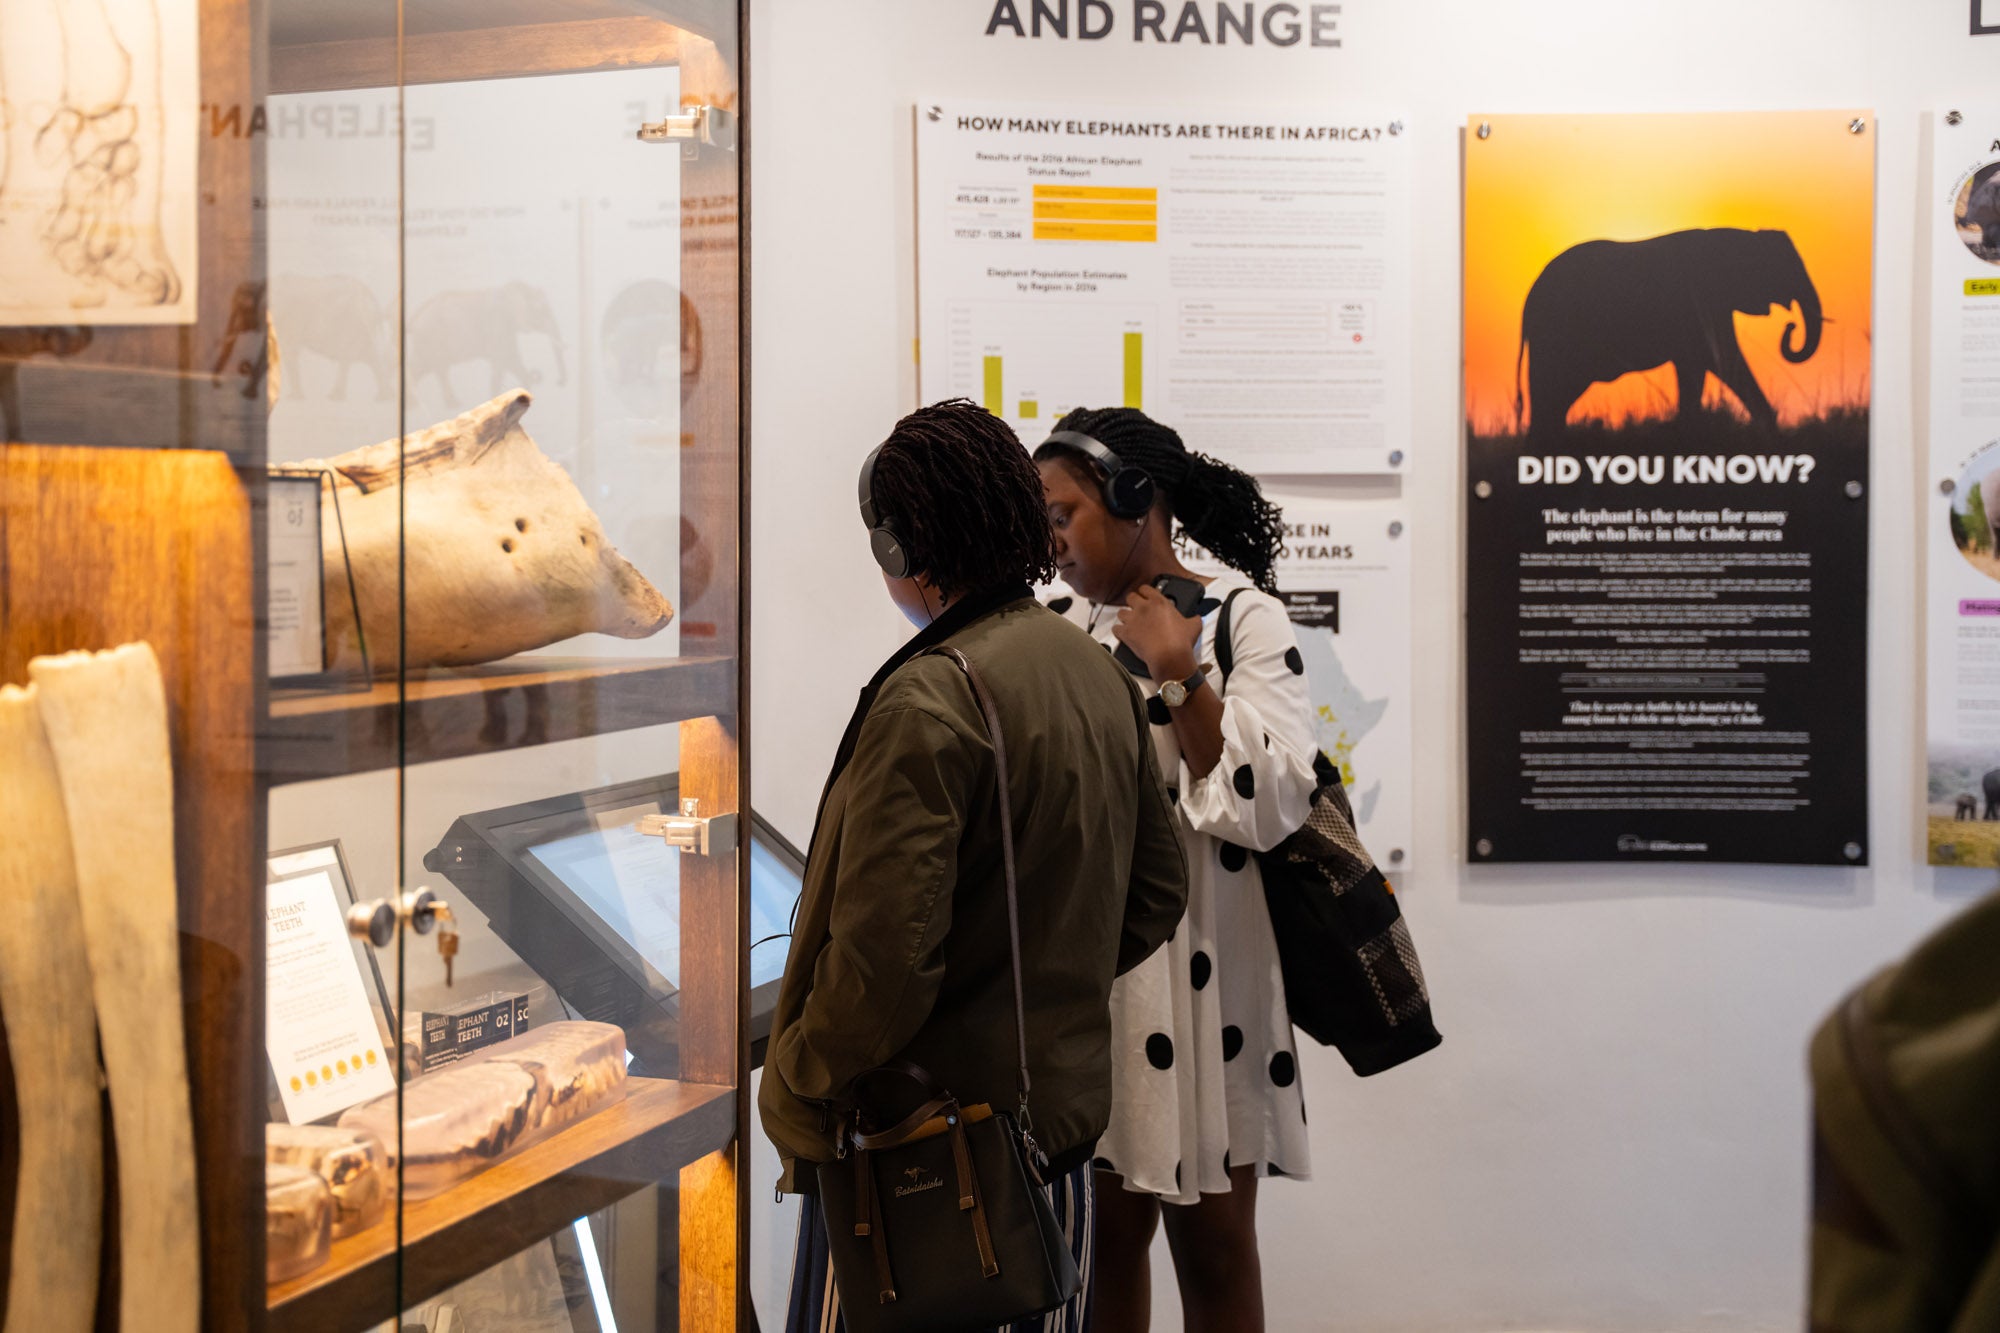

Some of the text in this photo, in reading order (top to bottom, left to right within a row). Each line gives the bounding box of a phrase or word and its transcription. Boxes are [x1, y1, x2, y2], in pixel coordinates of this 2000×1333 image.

[984, 0, 1342, 47] AND RANGE
[957, 116, 1381, 141] HOW MANY ELEPHANTS ARE THERE IN AFRICA?
[975, 151, 1010, 162] Results
[1013, 153, 1022, 162] of
[1023, 153, 1039, 163] the
[1066, 155, 1098, 165] African
[1101, 156, 1142, 167] Elephant
[1027, 167, 1091, 179] Status Report
[987, 267, 1128, 280] Elephant Population Estimates
[1017, 282, 1028, 292] by
[1031, 282, 1062, 293] Region
[1517, 454, 1816, 484] DID YOU KNOW?
[1541, 507, 1788, 526] The elephant is the totem for many
[1311, 524, 1330, 538] IN
[1546, 526, 1783, 545] people who live in the Chobe area
[1294, 545, 1354, 559] YEARS
[266, 901, 306, 921] LEPHANT
[272, 916, 303, 933] TEETH
[496, 1013, 509, 1028] 02
[457, 1026, 482, 1043] TEETH
